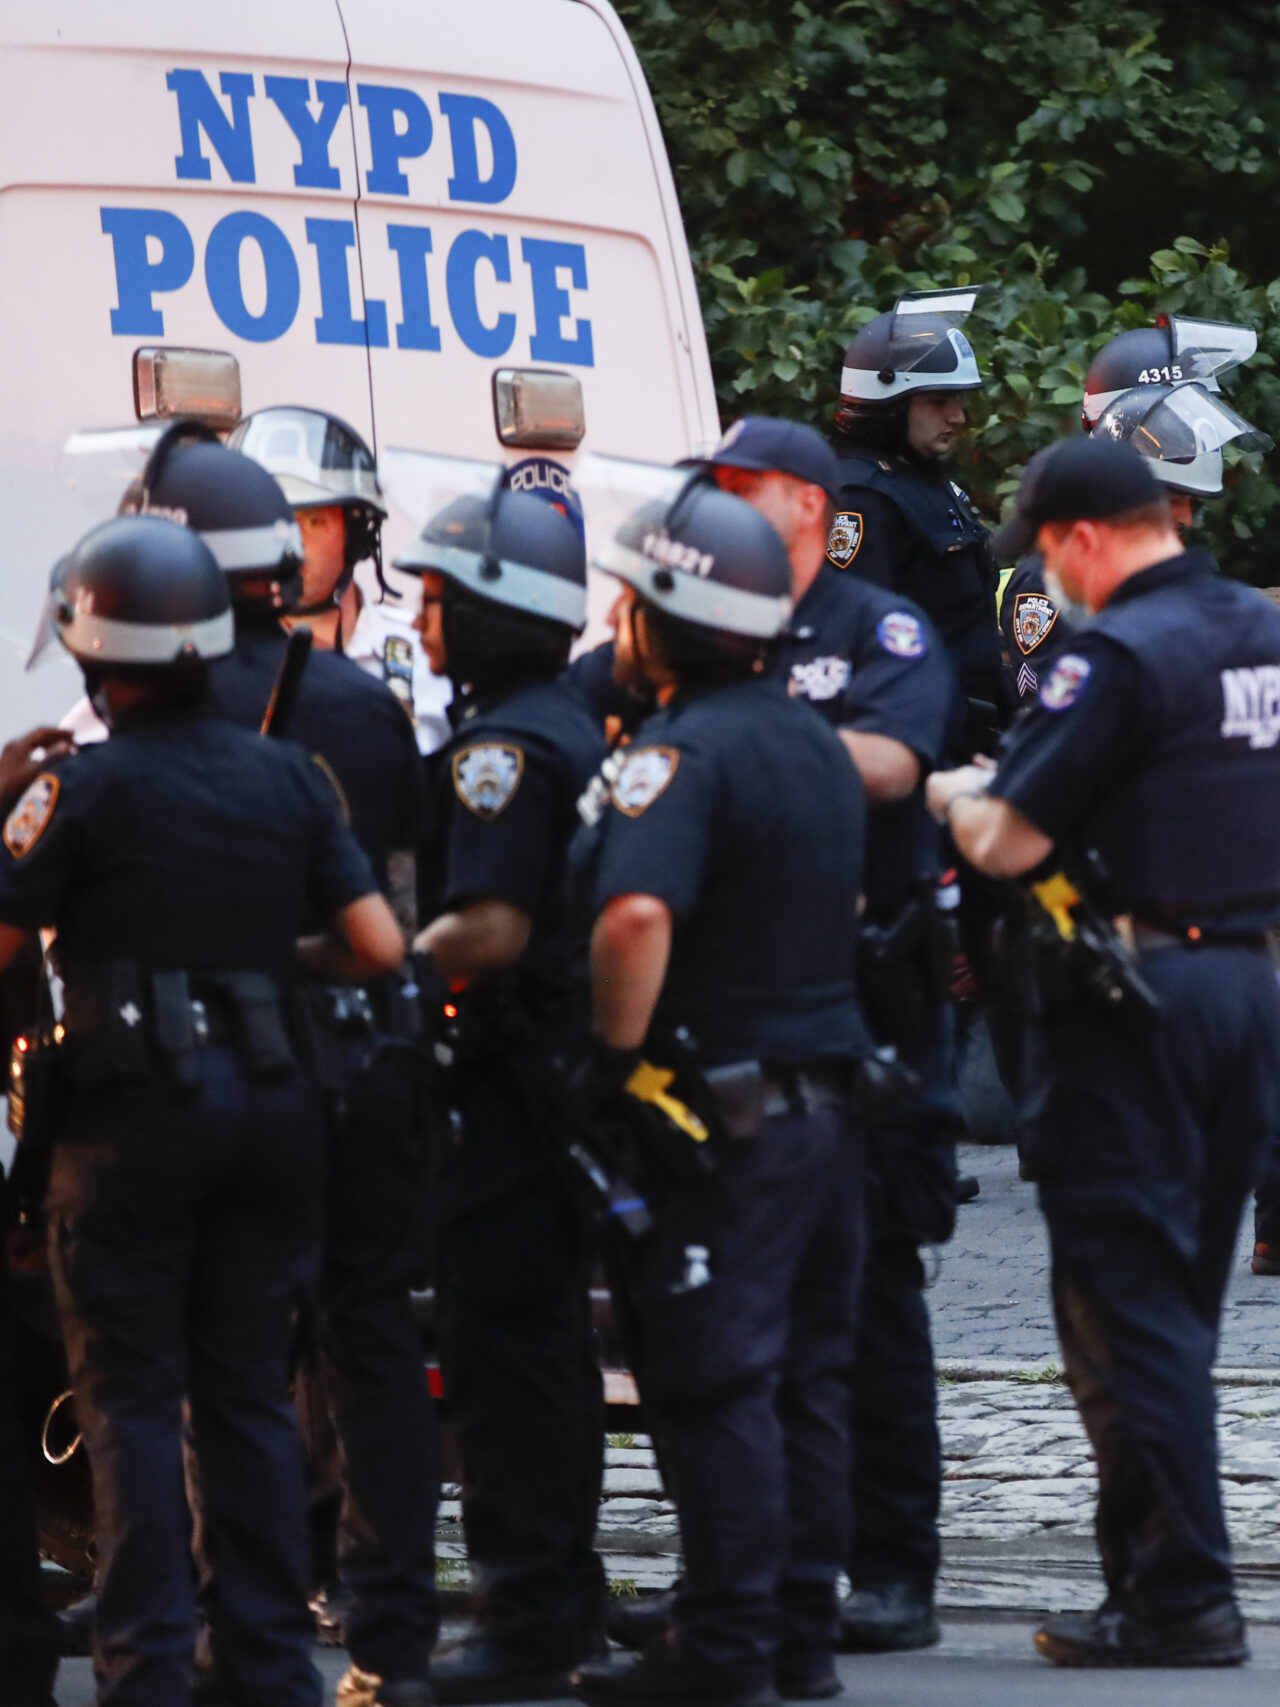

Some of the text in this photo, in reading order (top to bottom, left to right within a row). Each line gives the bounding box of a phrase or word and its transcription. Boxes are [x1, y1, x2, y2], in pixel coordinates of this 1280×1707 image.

[166, 68, 517, 205] NYPD
[99, 206, 595, 368] POLICE
[1138, 365, 1183, 384] 4315
